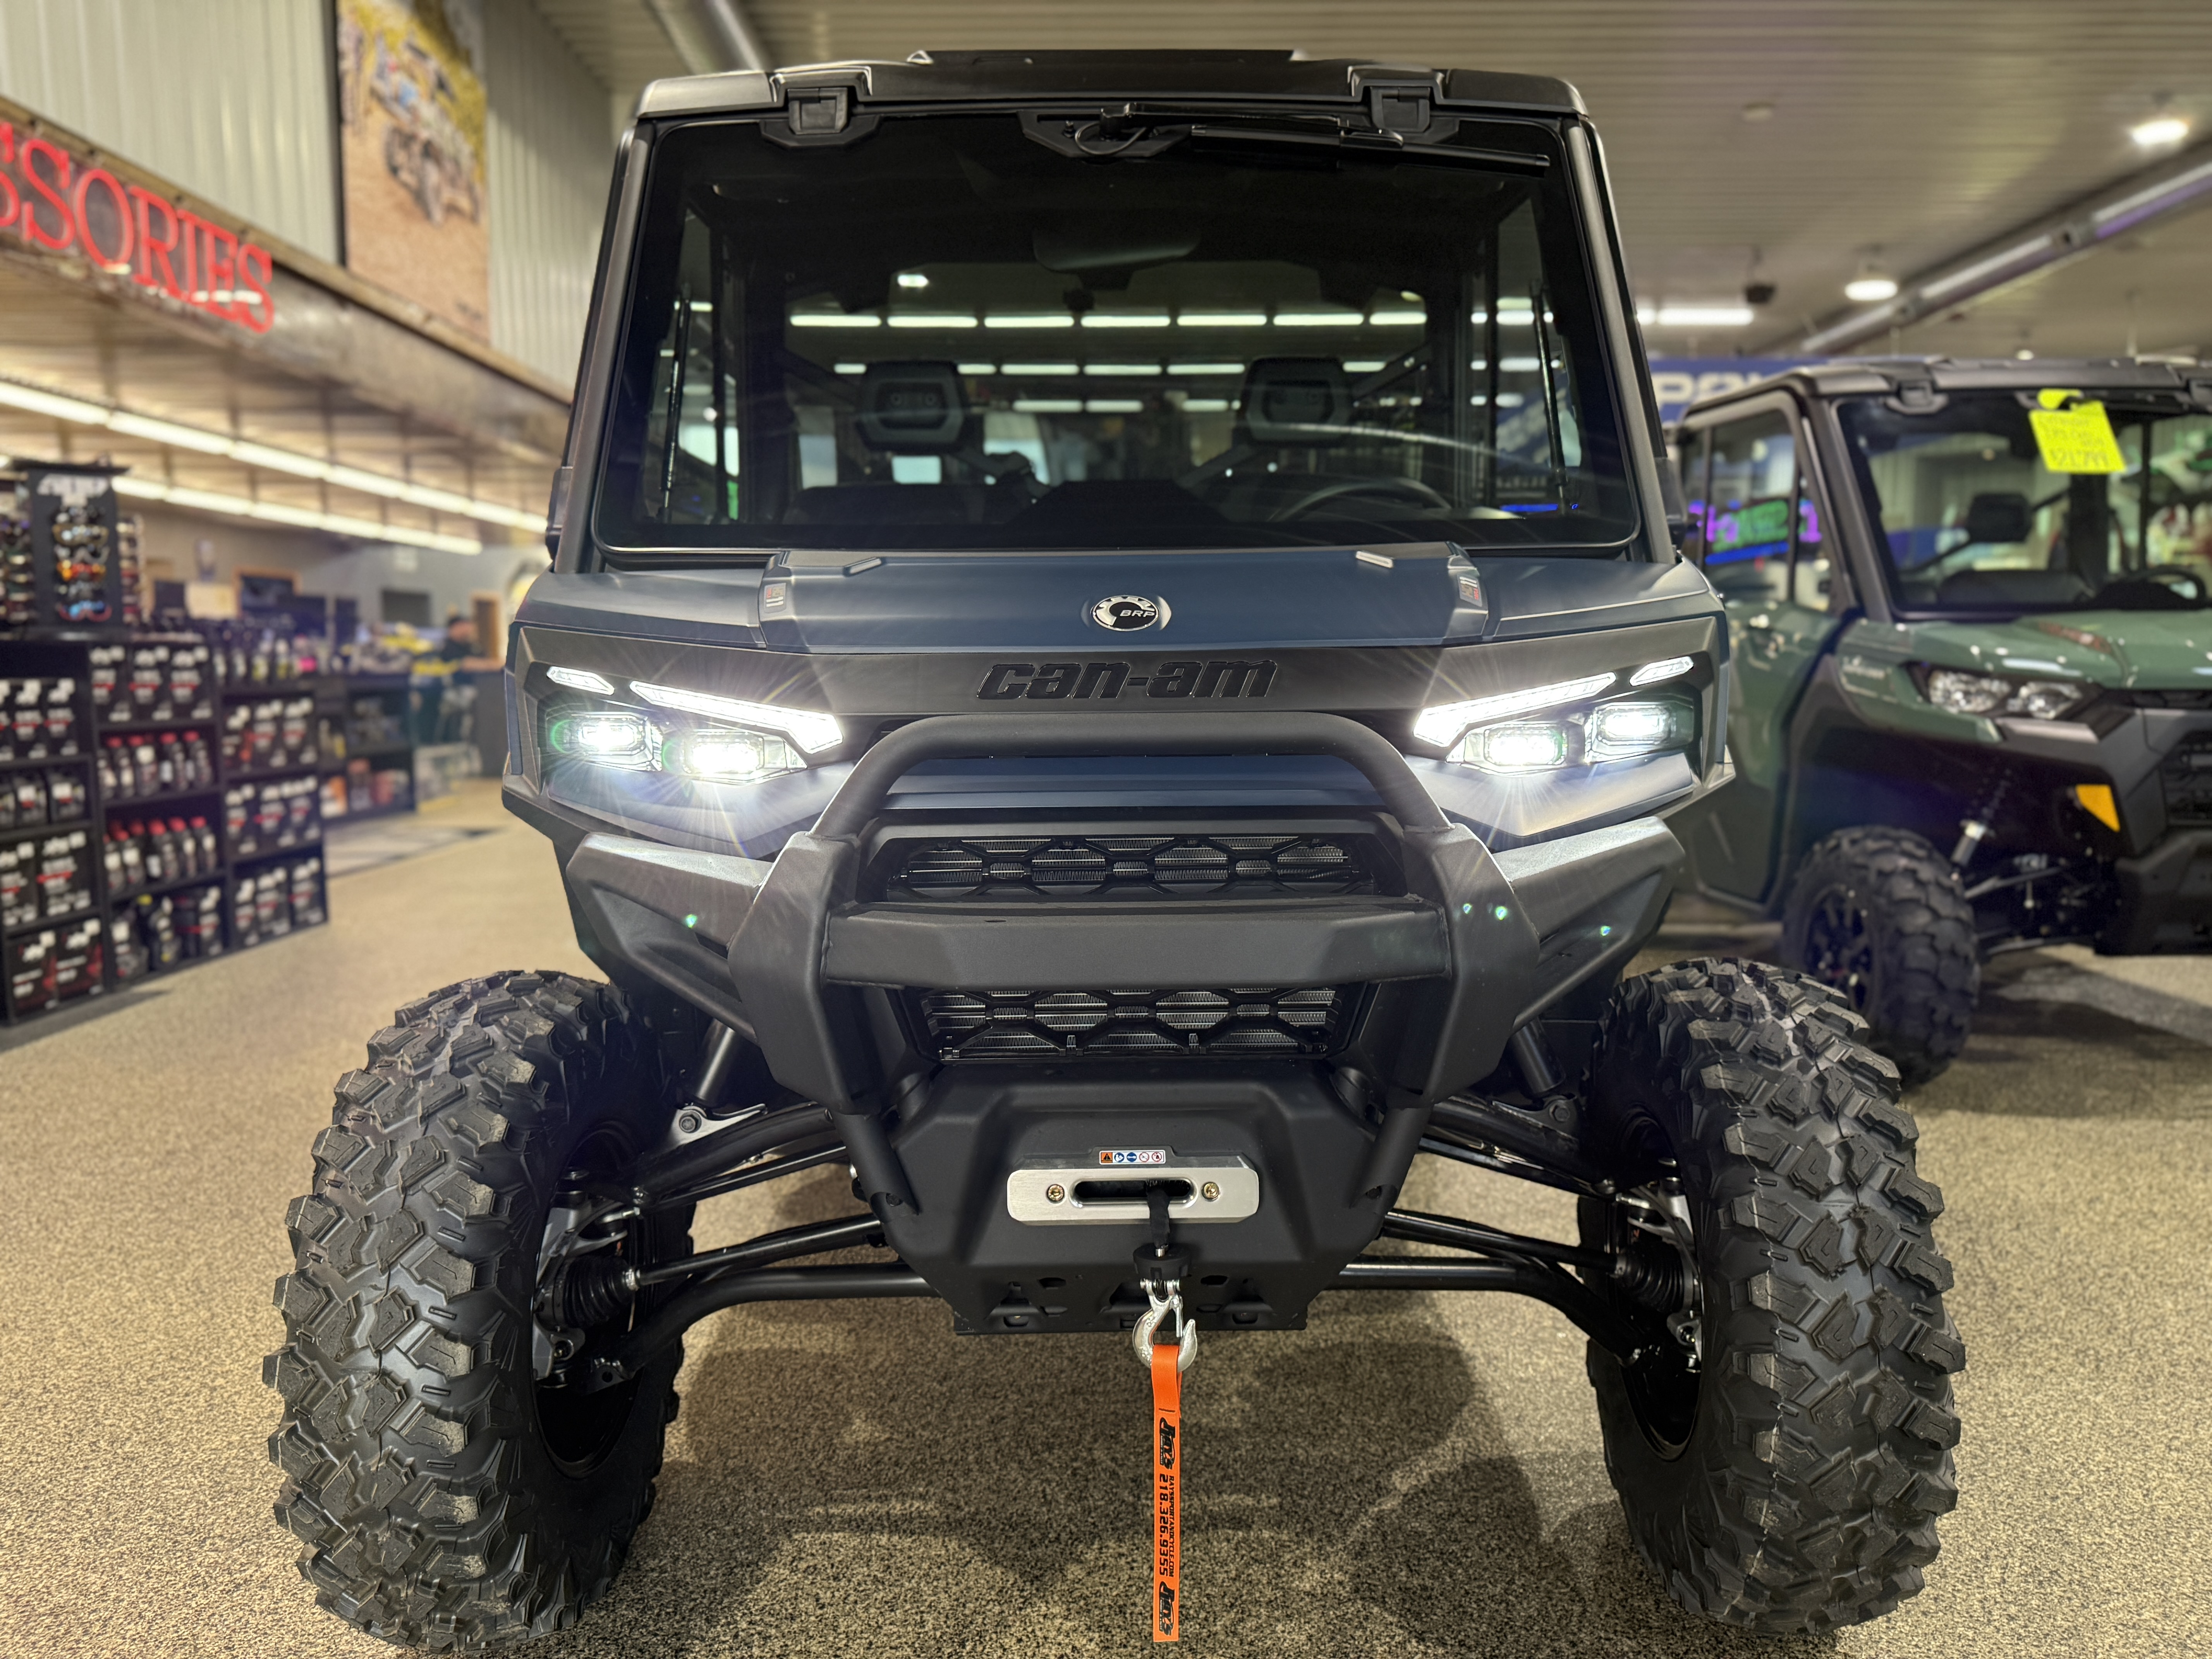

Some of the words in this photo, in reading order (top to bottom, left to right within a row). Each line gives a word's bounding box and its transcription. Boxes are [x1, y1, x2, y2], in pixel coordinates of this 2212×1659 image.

[1120, 610, 1155, 618] BRP
[977, 660, 1278, 699] can-am
[1159, 1473, 1169, 1577] 218.326.9355
